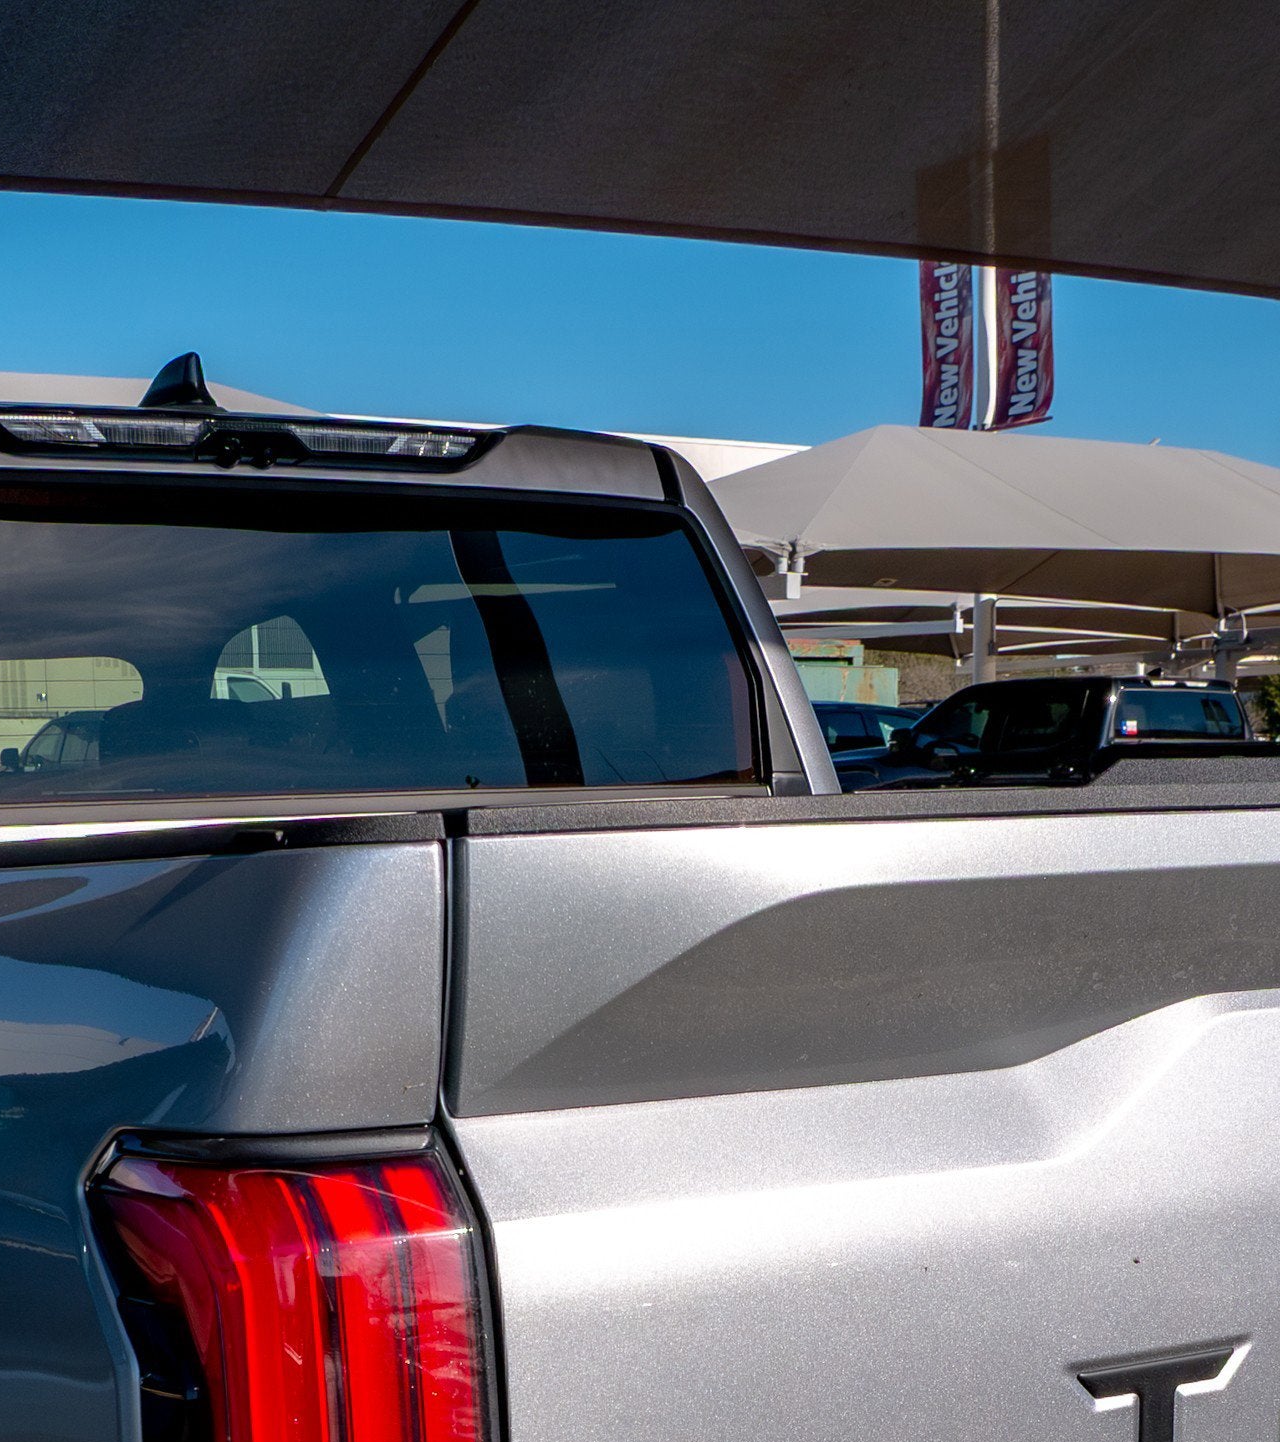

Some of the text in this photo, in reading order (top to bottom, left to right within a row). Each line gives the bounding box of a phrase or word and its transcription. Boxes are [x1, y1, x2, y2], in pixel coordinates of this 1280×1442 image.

[933, 260, 959, 427] New Vehicl
[1008, 348, 1038, 417] New
